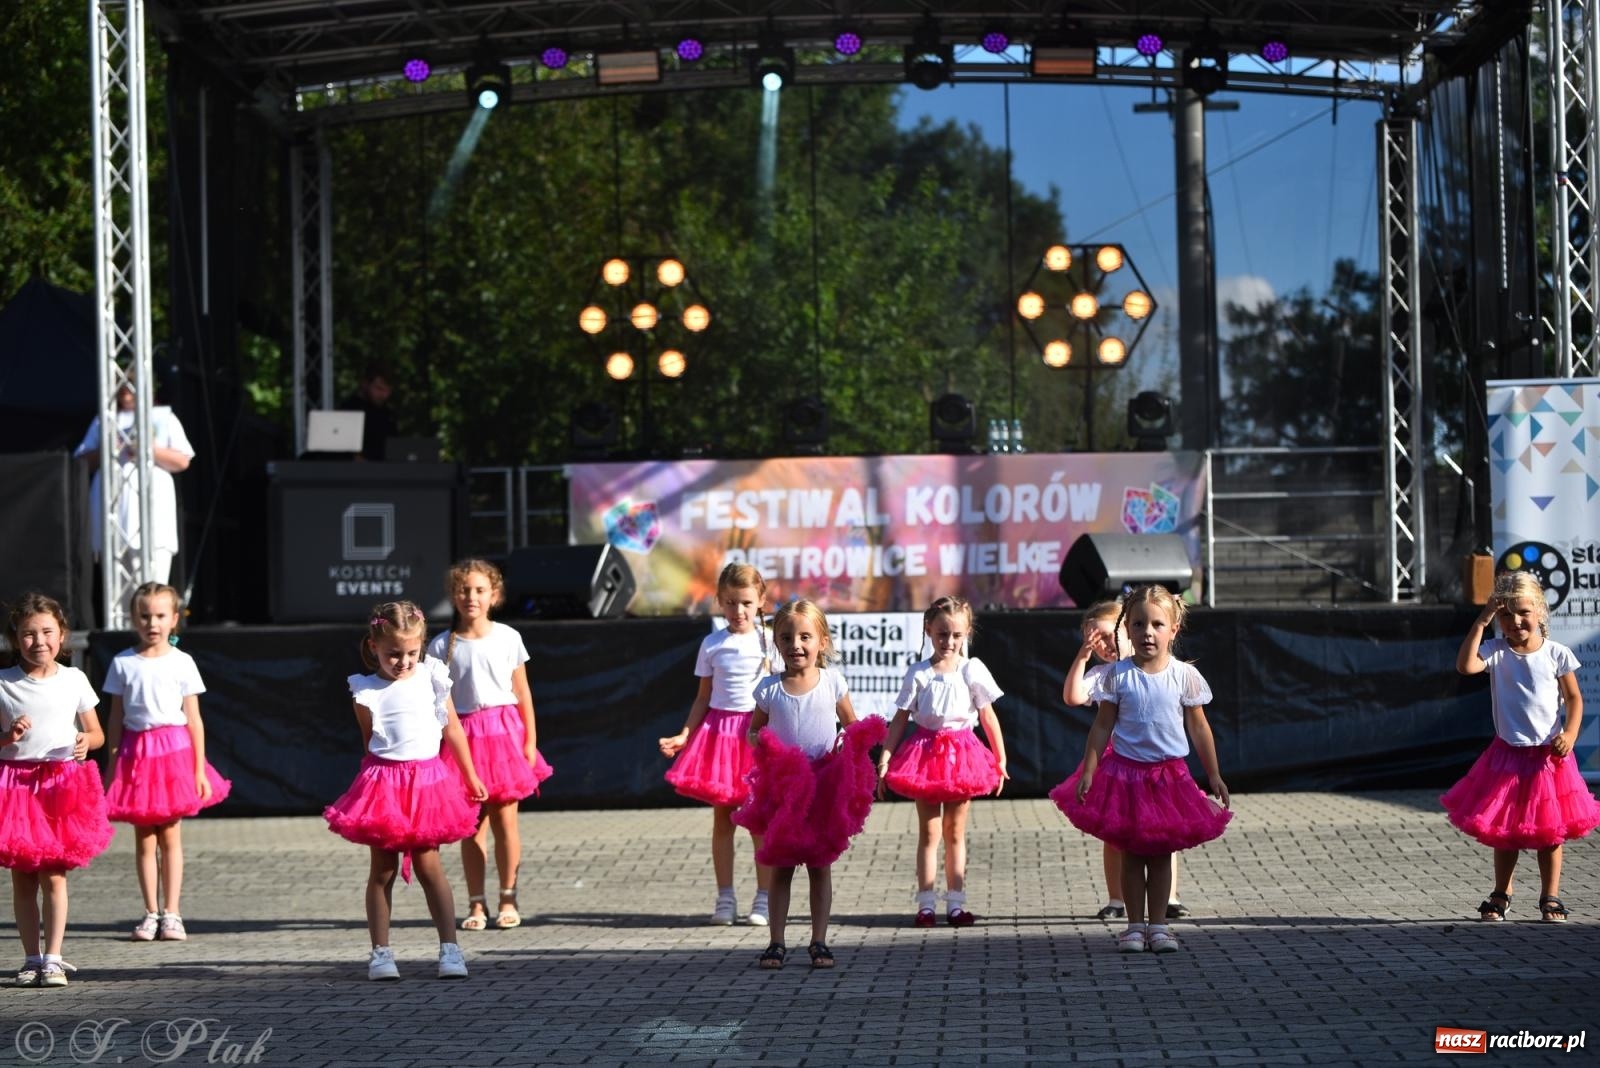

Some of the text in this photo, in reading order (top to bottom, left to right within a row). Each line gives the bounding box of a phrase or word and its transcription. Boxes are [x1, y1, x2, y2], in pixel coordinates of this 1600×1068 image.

[680, 471, 1102, 531] FESTIWAL KOLORÓW
[328, 565, 411, 579] KOSTECH
[336, 581, 403, 595] EVENTS
